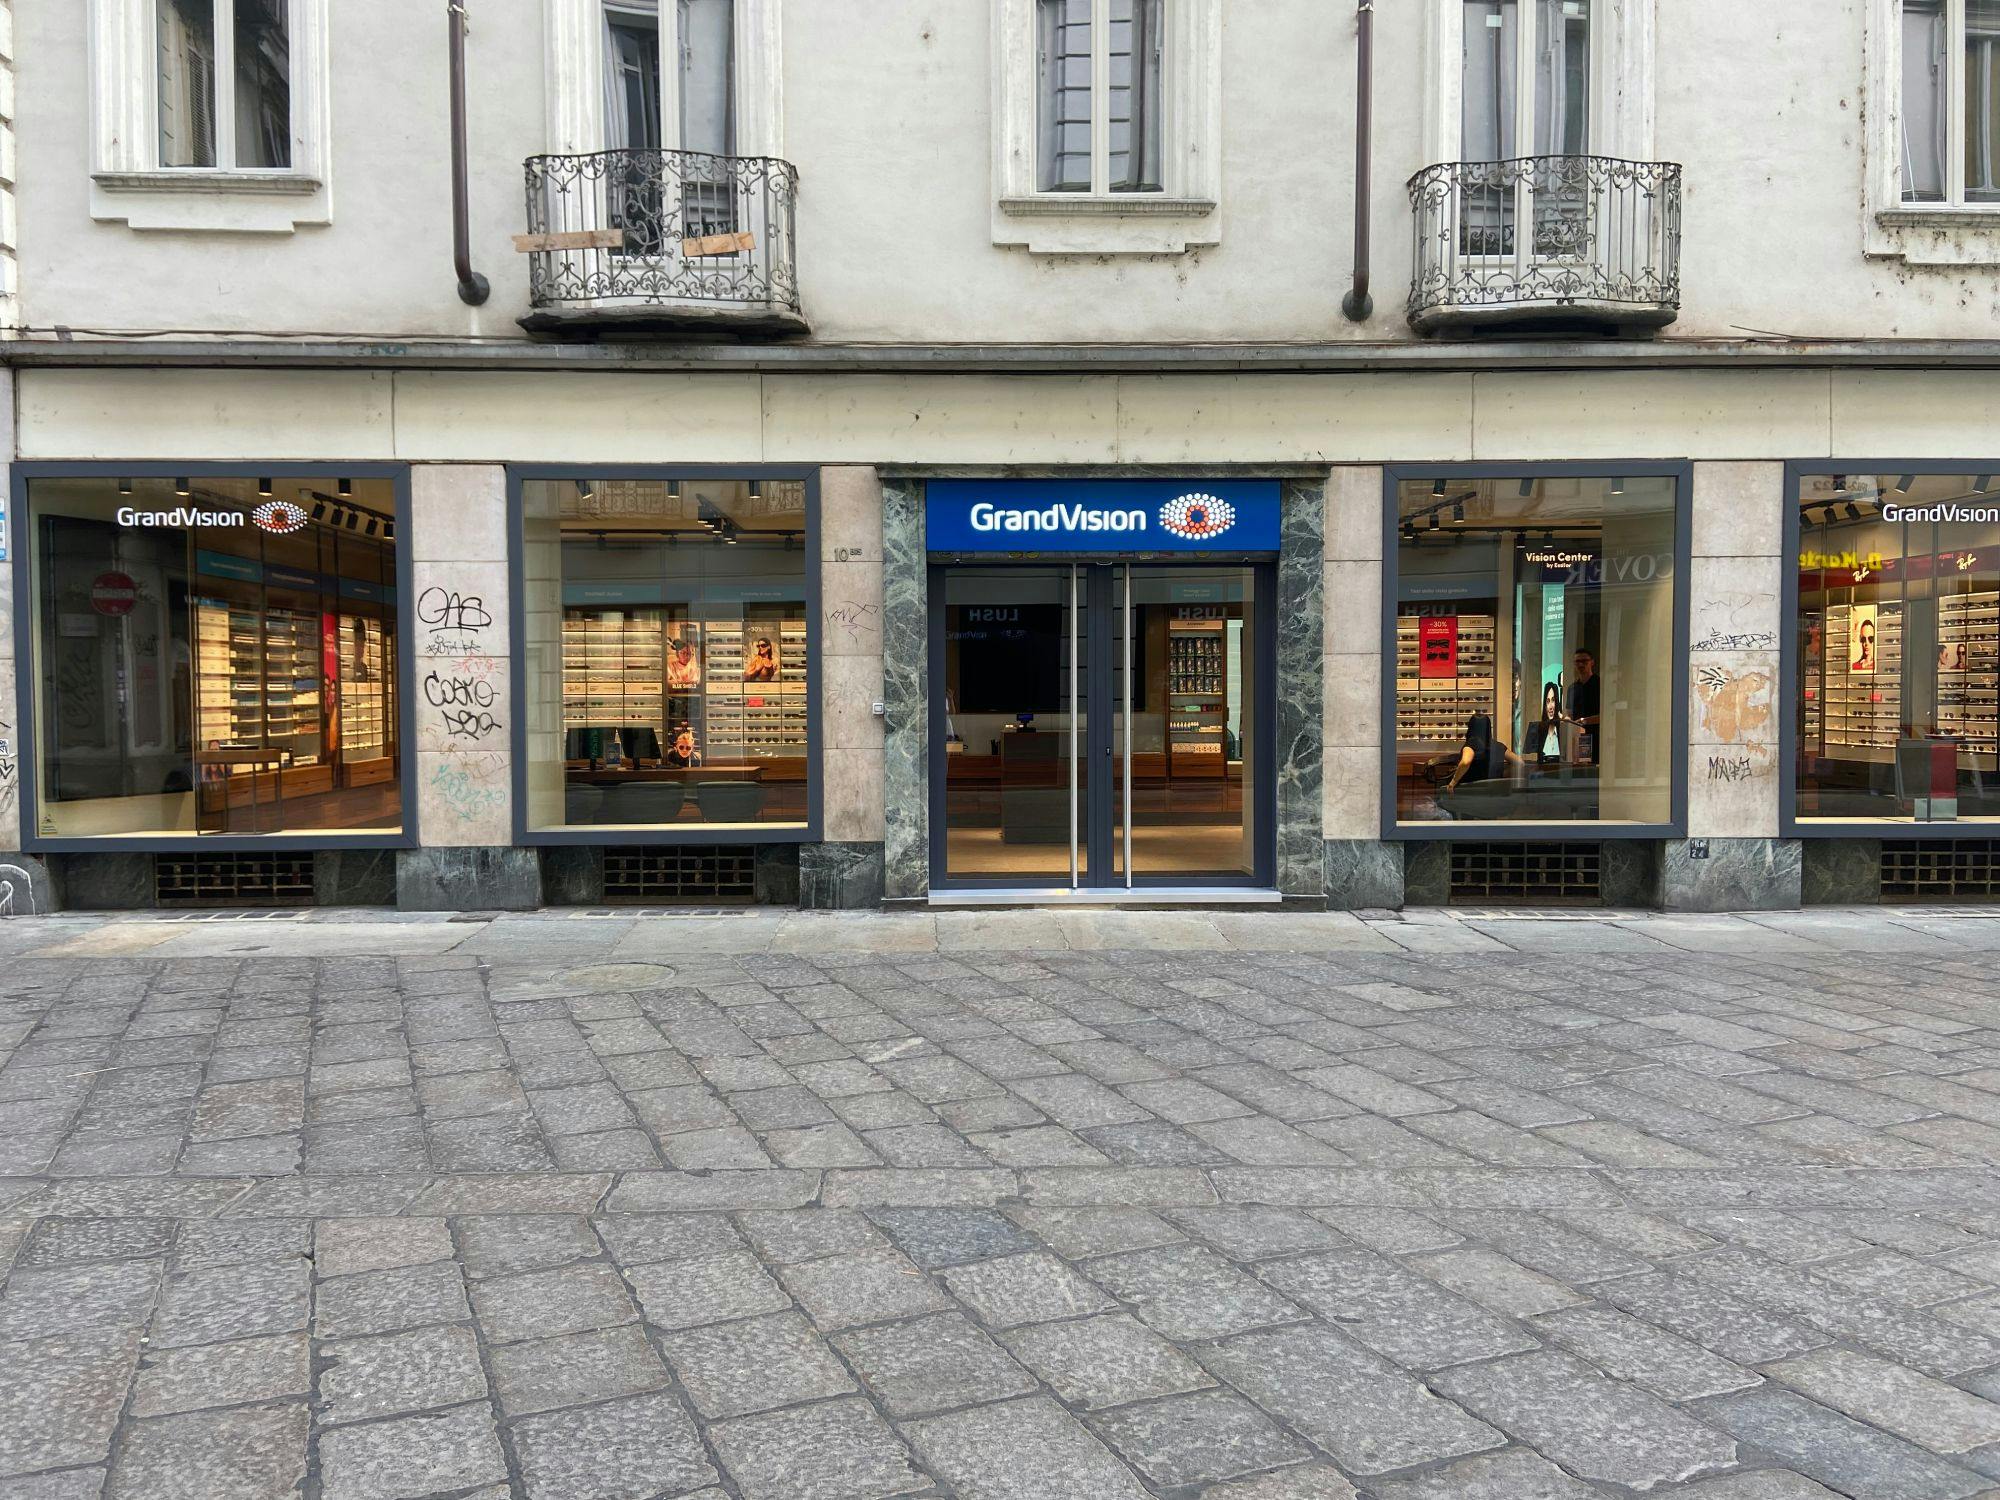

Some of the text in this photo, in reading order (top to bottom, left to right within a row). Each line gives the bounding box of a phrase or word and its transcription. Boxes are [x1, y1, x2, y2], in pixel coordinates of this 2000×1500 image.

[117, 507, 244, 527] GrandVision
[970, 503, 1147, 531] GrandVision
[1882, 504, 1999, 522] GrandVision
[1525, 552, 1593, 562] Vision Center
